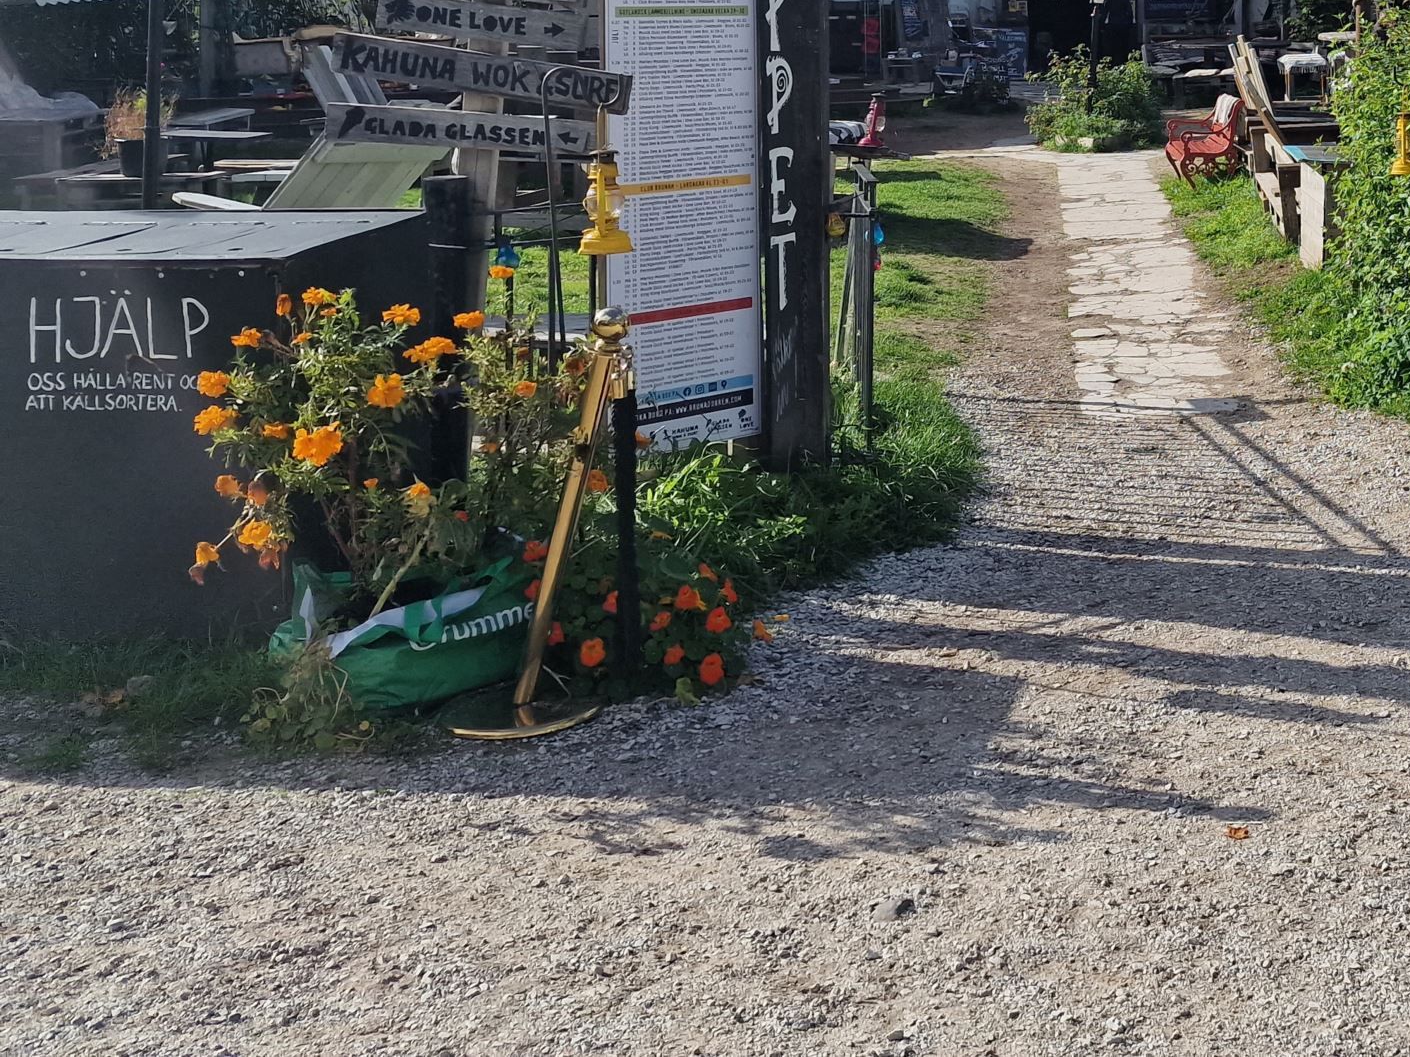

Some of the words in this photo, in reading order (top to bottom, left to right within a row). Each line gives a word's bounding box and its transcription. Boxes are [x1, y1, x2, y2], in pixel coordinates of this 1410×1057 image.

[415, 6, 462, 27] ONE
[469, 11, 527, 36] LOVE
[340, 44, 455, 82] KAHUNA
[470, 61, 531, 92] WOK
[364, 116, 436, 139] GLADA
[446, 122, 546, 146] GLASSEN
[29, 289, 209, 363] HJÄLP
[27, 371, 65, 391] OSS
[73, 368, 126, 390] HÅLLA
[132, 372, 175, 390] RENT
[180, 373, 199, 390] OC
[25, 394, 55, 411] ATT
[62, 391, 182, 412] KÄLLSORTERA.
